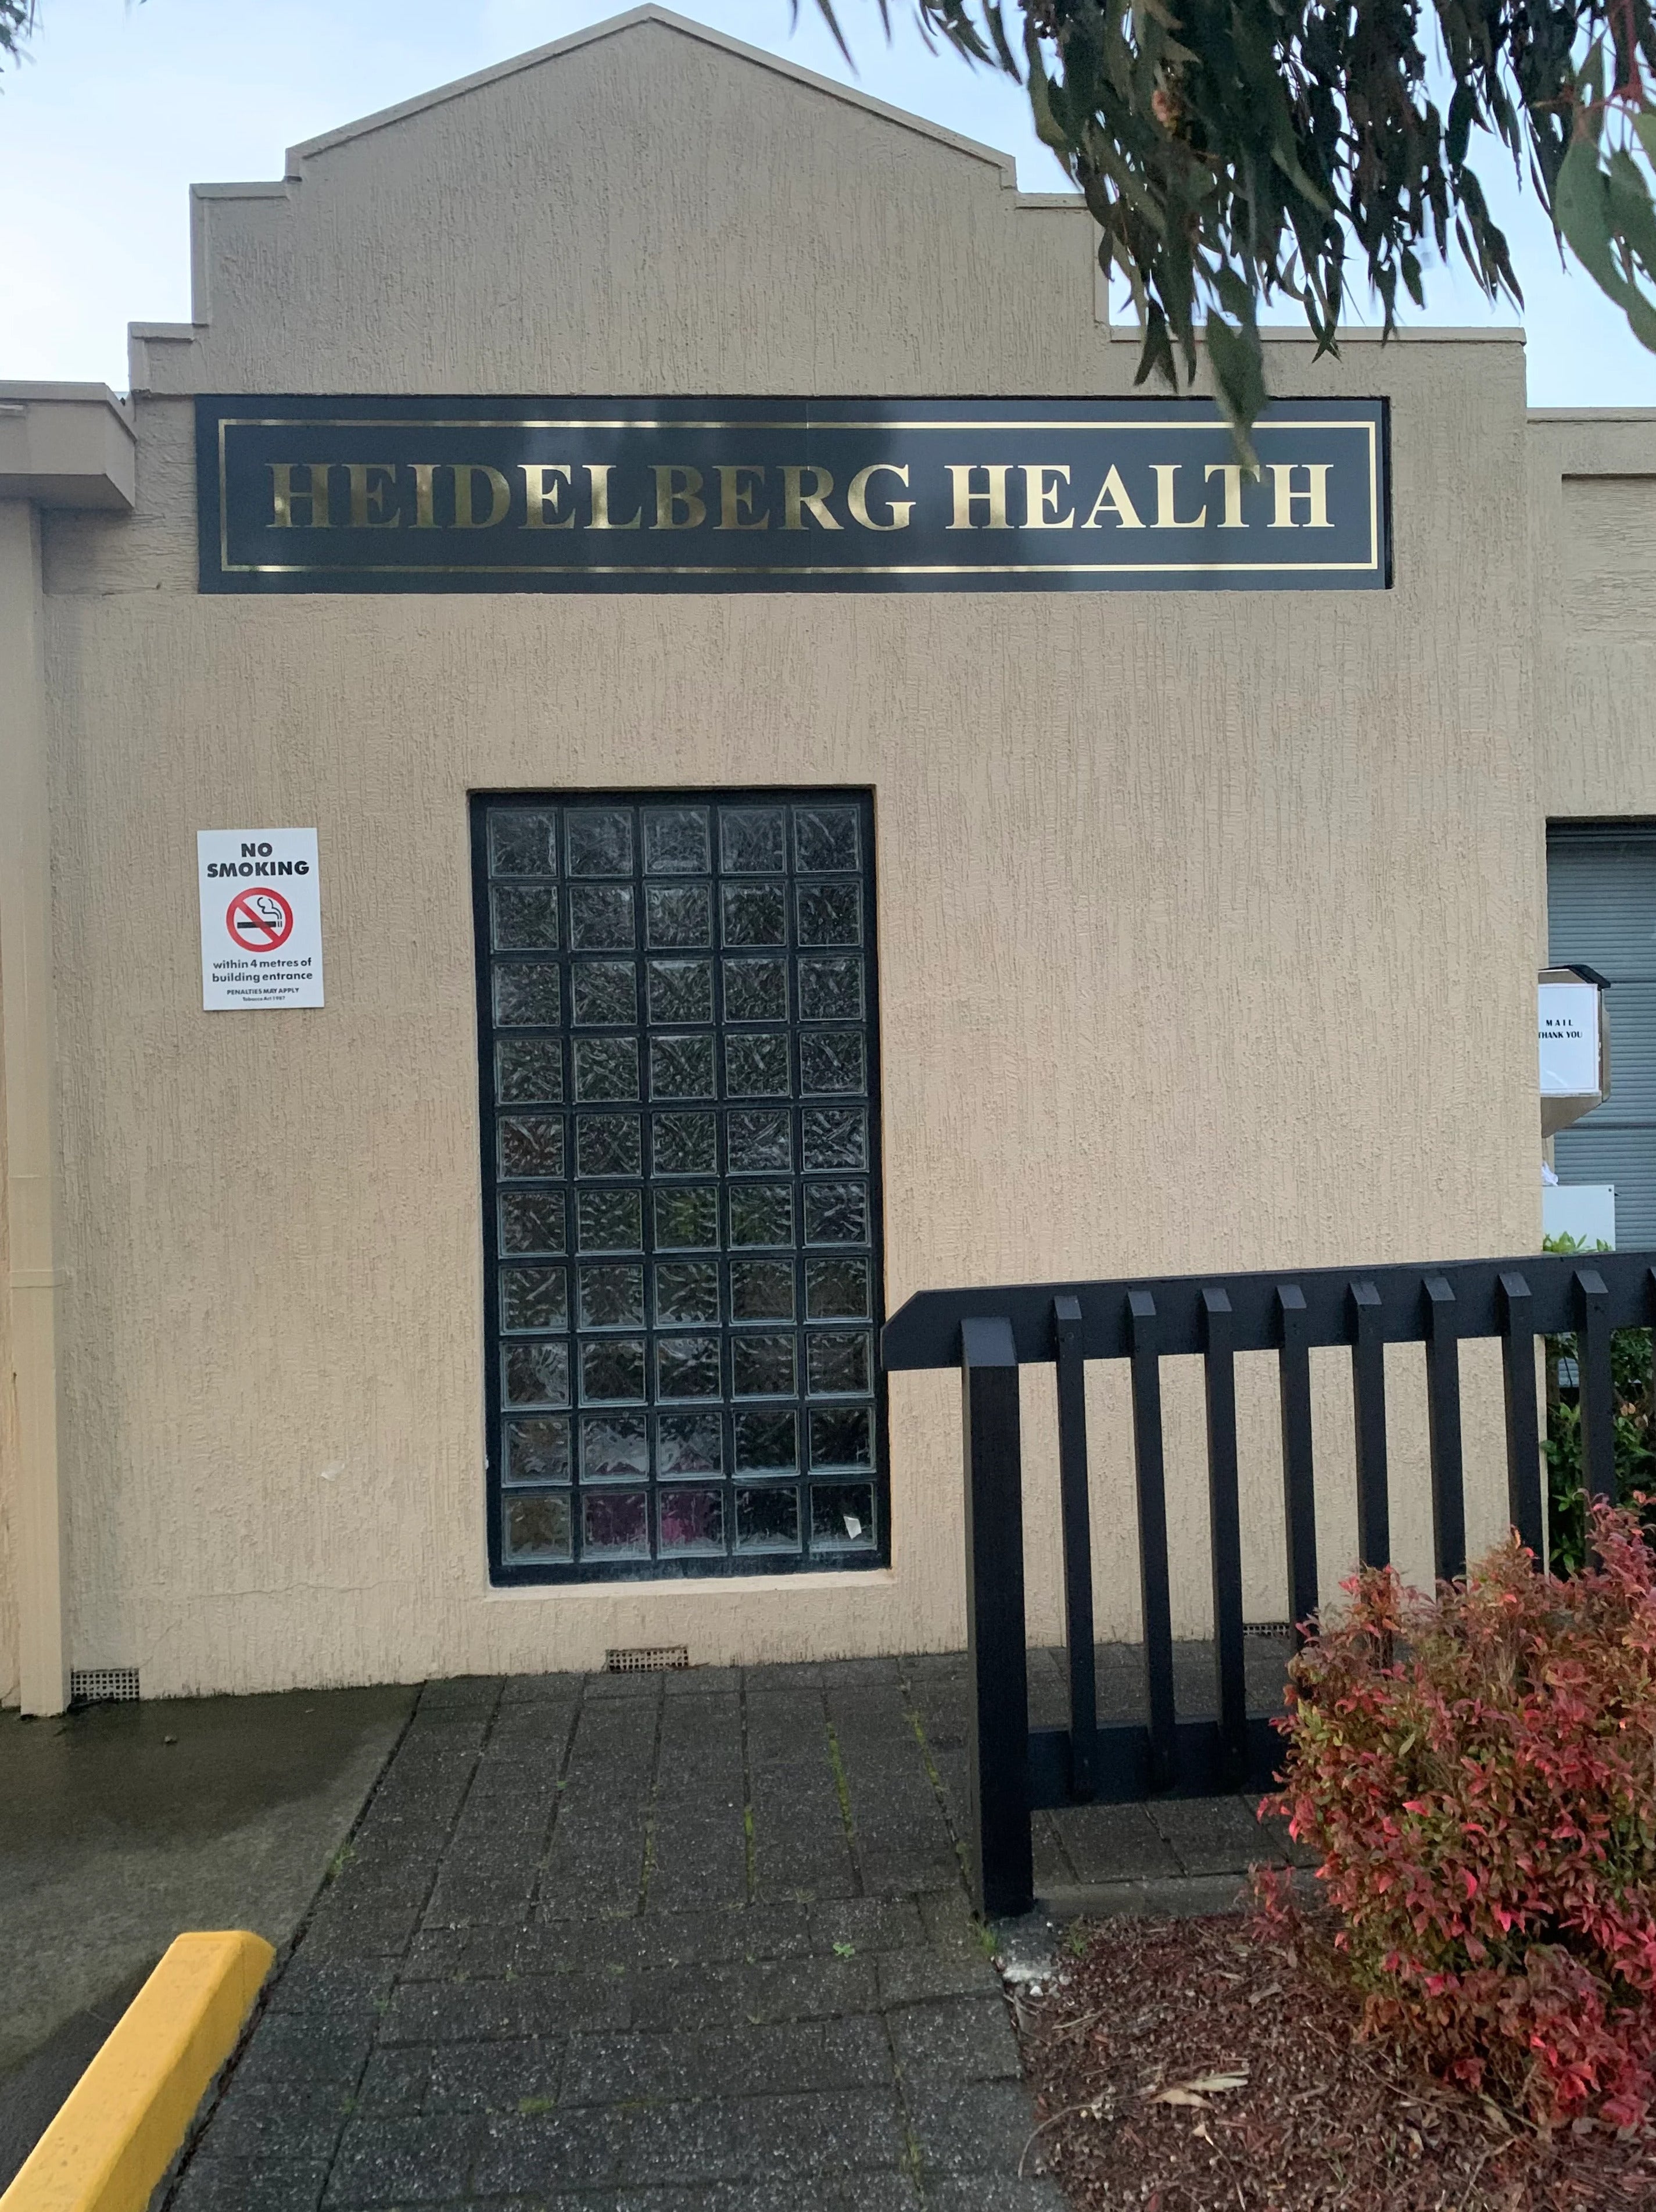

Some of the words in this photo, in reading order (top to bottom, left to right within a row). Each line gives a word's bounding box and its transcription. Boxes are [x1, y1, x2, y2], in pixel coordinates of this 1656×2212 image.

[265, 463, 916, 531] HEIDELBERG
[944, 463, 1335, 529] HEALTH
[241, 843, 273, 857] NO
[207, 861, 310, 878] SMOKING
[213, 960, 248, 969] within
[250, 960, 257, 968] 4
[259, 960, 299, 968] metres
[300, 957, 311, 967] of
[212, 972, 260, 983] building
[262, 972, 313, 980] entrance
